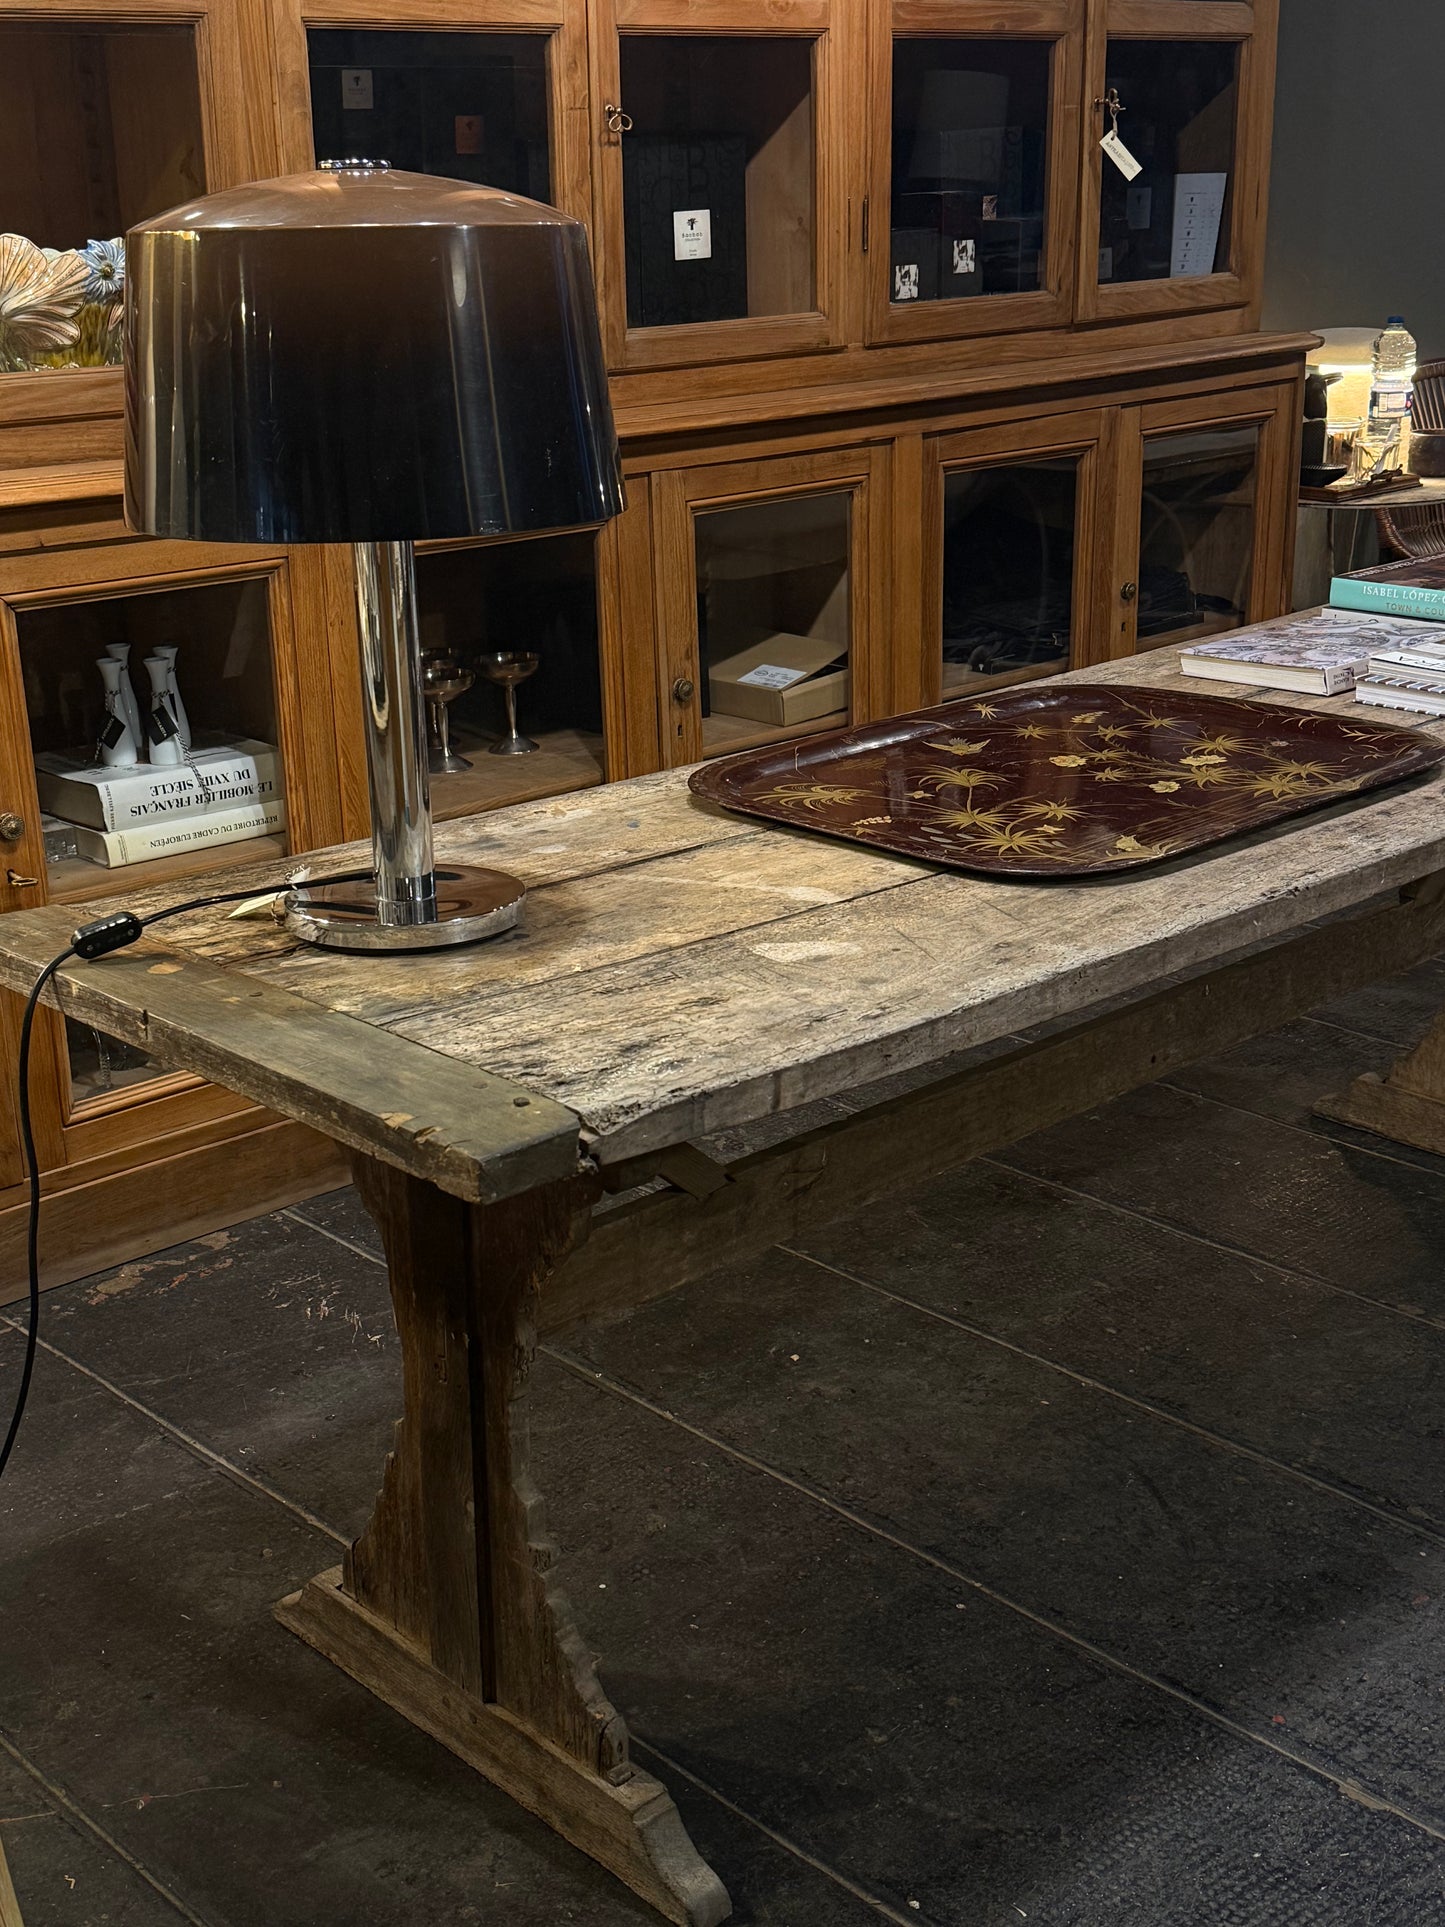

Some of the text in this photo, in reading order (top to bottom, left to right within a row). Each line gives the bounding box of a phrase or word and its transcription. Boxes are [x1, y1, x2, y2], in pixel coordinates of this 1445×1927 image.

[1363, 585, 1445, 604] ISABEL LÓPEZ-
[1385, 602, 1412, 613] TOWN
[233, 768, 251, 781] DU
[149, 779, 194, 796] SIÈCLE
[130, 780, 274, 817] LE MOBILIER FRANÇAIS
[150, 815, 278, 848] RÉPERTOIRE DU CADRE EUROPÉEN
